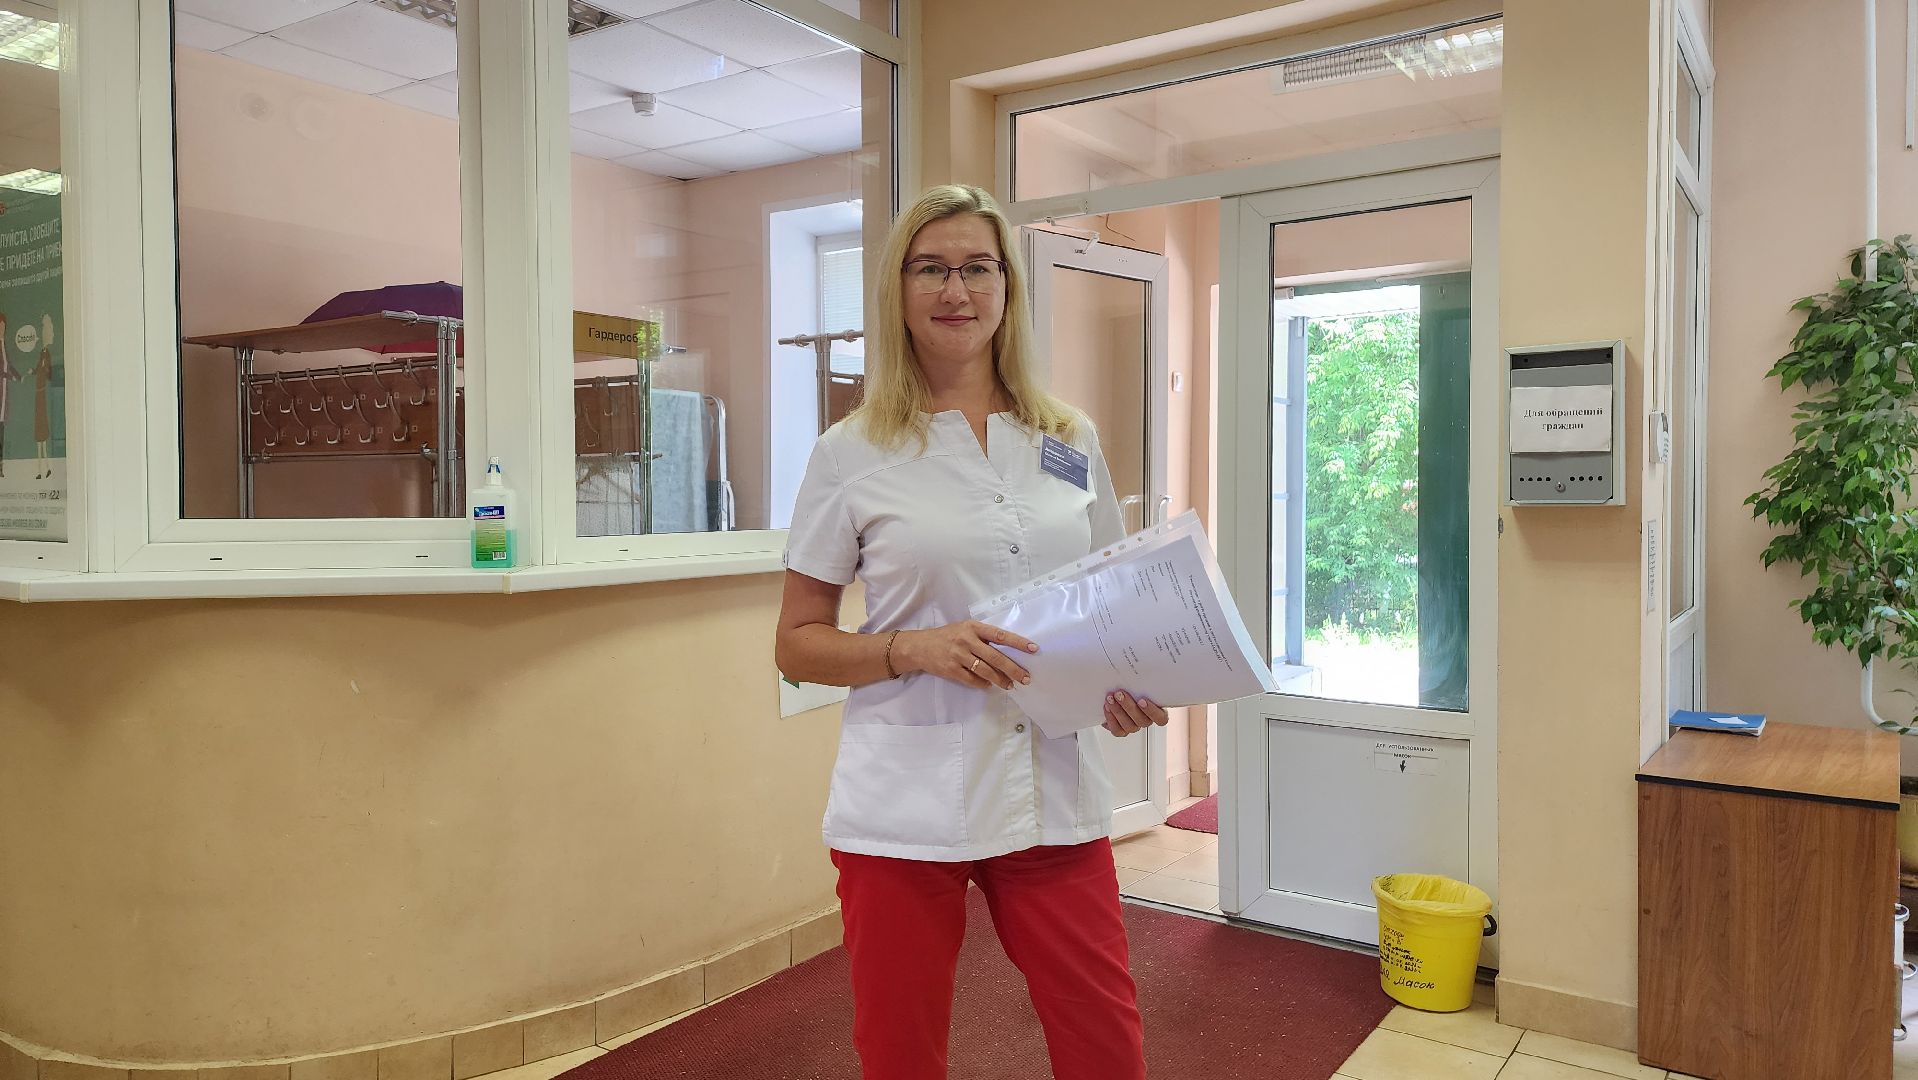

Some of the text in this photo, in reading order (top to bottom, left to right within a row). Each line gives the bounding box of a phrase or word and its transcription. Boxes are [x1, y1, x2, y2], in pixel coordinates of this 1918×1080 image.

[588, 327, 638, 343] Гардероб
[1524, 407, 1603, 418] Для обращений
[1542, 423, 1584, 432] граждан
